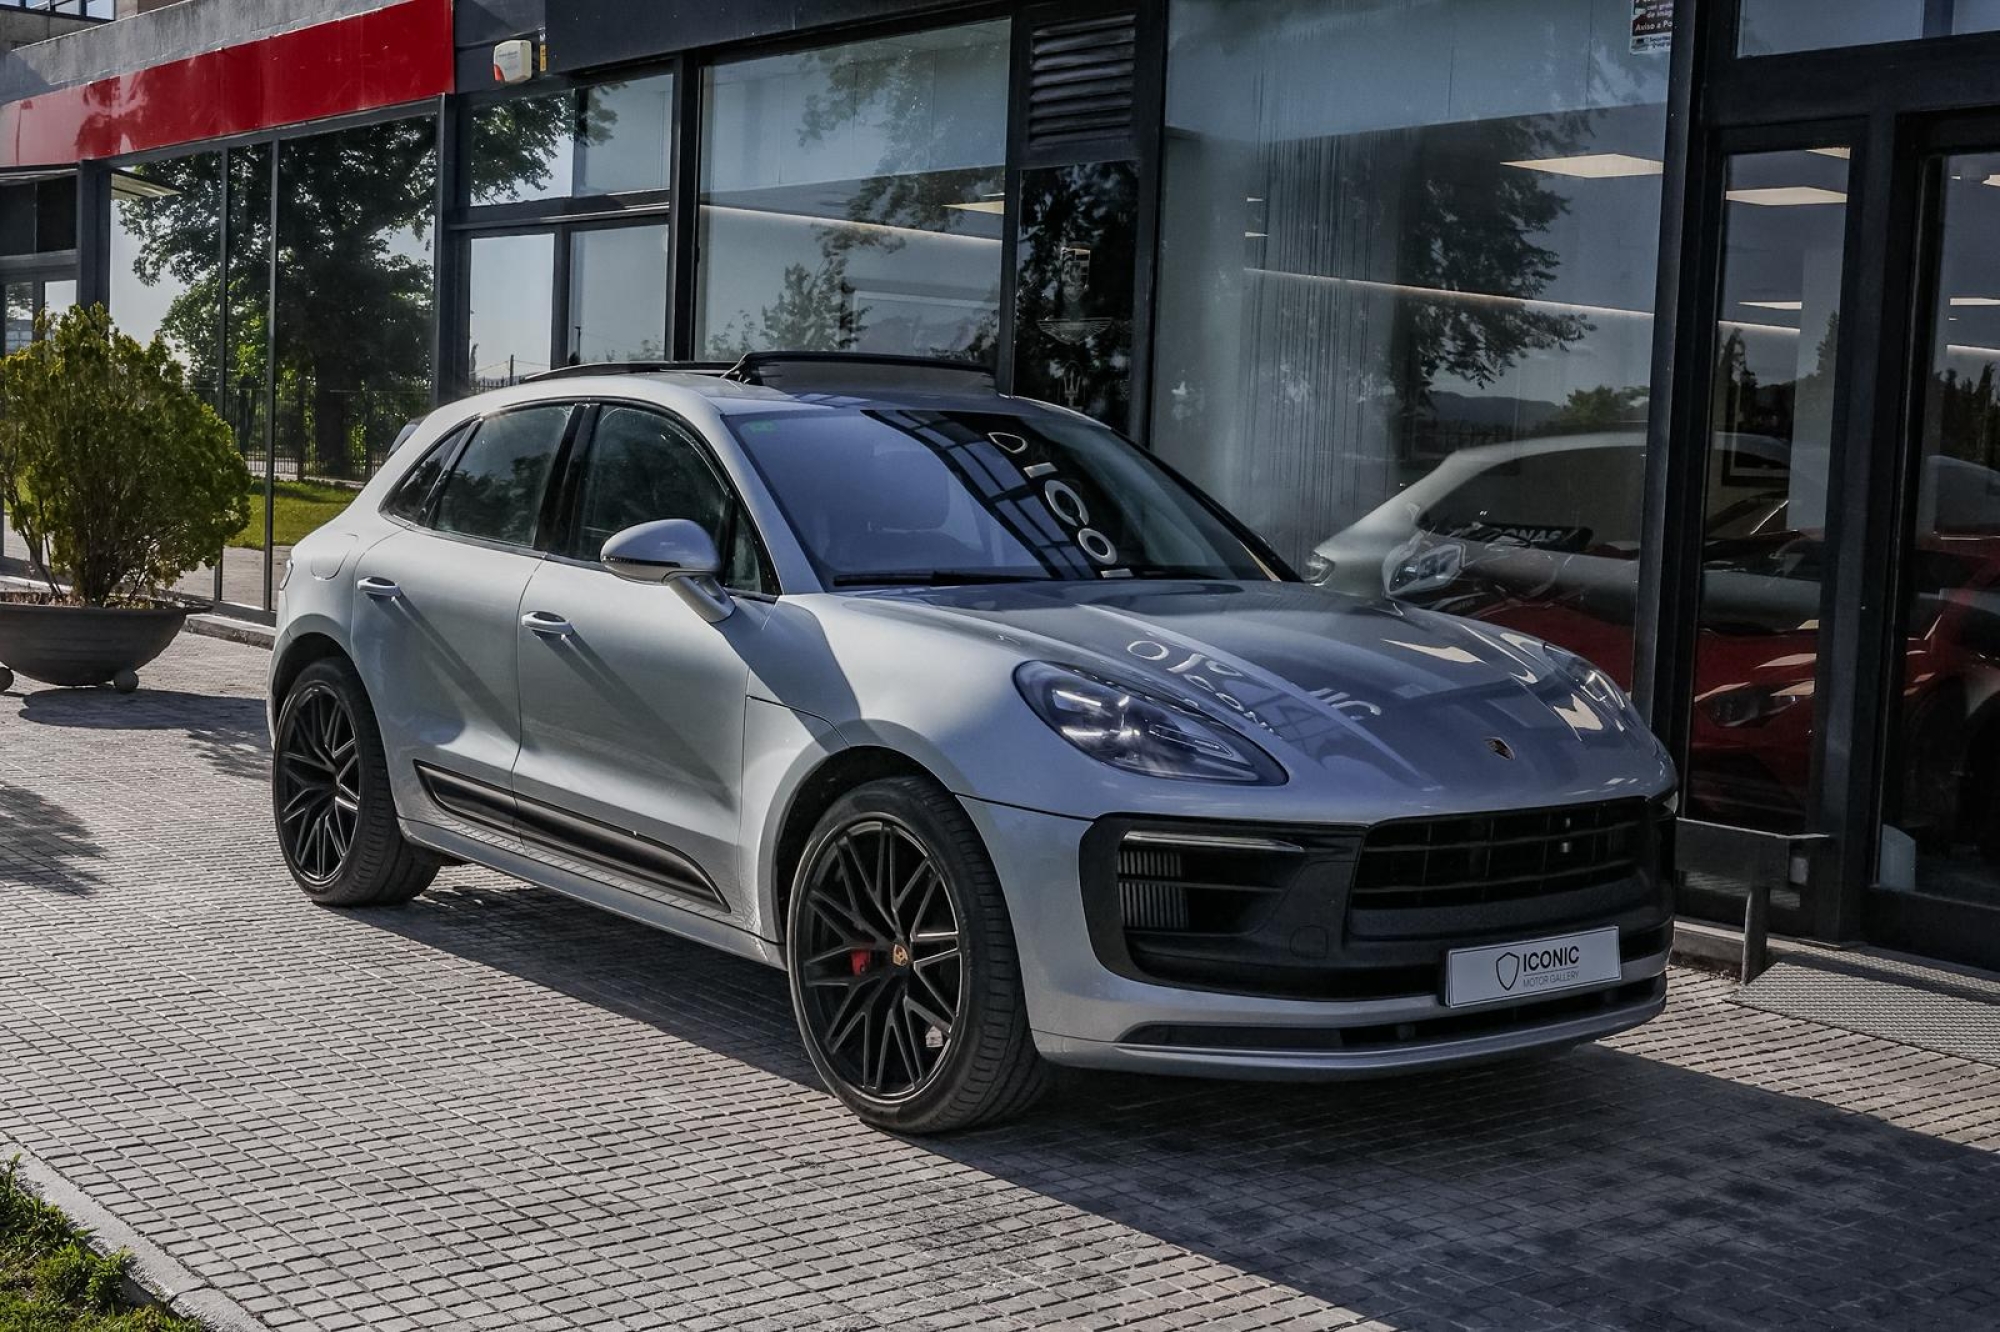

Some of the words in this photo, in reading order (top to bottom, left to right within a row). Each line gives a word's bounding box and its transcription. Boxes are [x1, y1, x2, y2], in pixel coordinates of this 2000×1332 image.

[1635, 22, 1656, 31] Aviso
[1523, 945, 1580, 973] ICONIC
[1523, 974, 1550, 988] MOTOR
[1549, 970, 1580, 983] GALLERY
